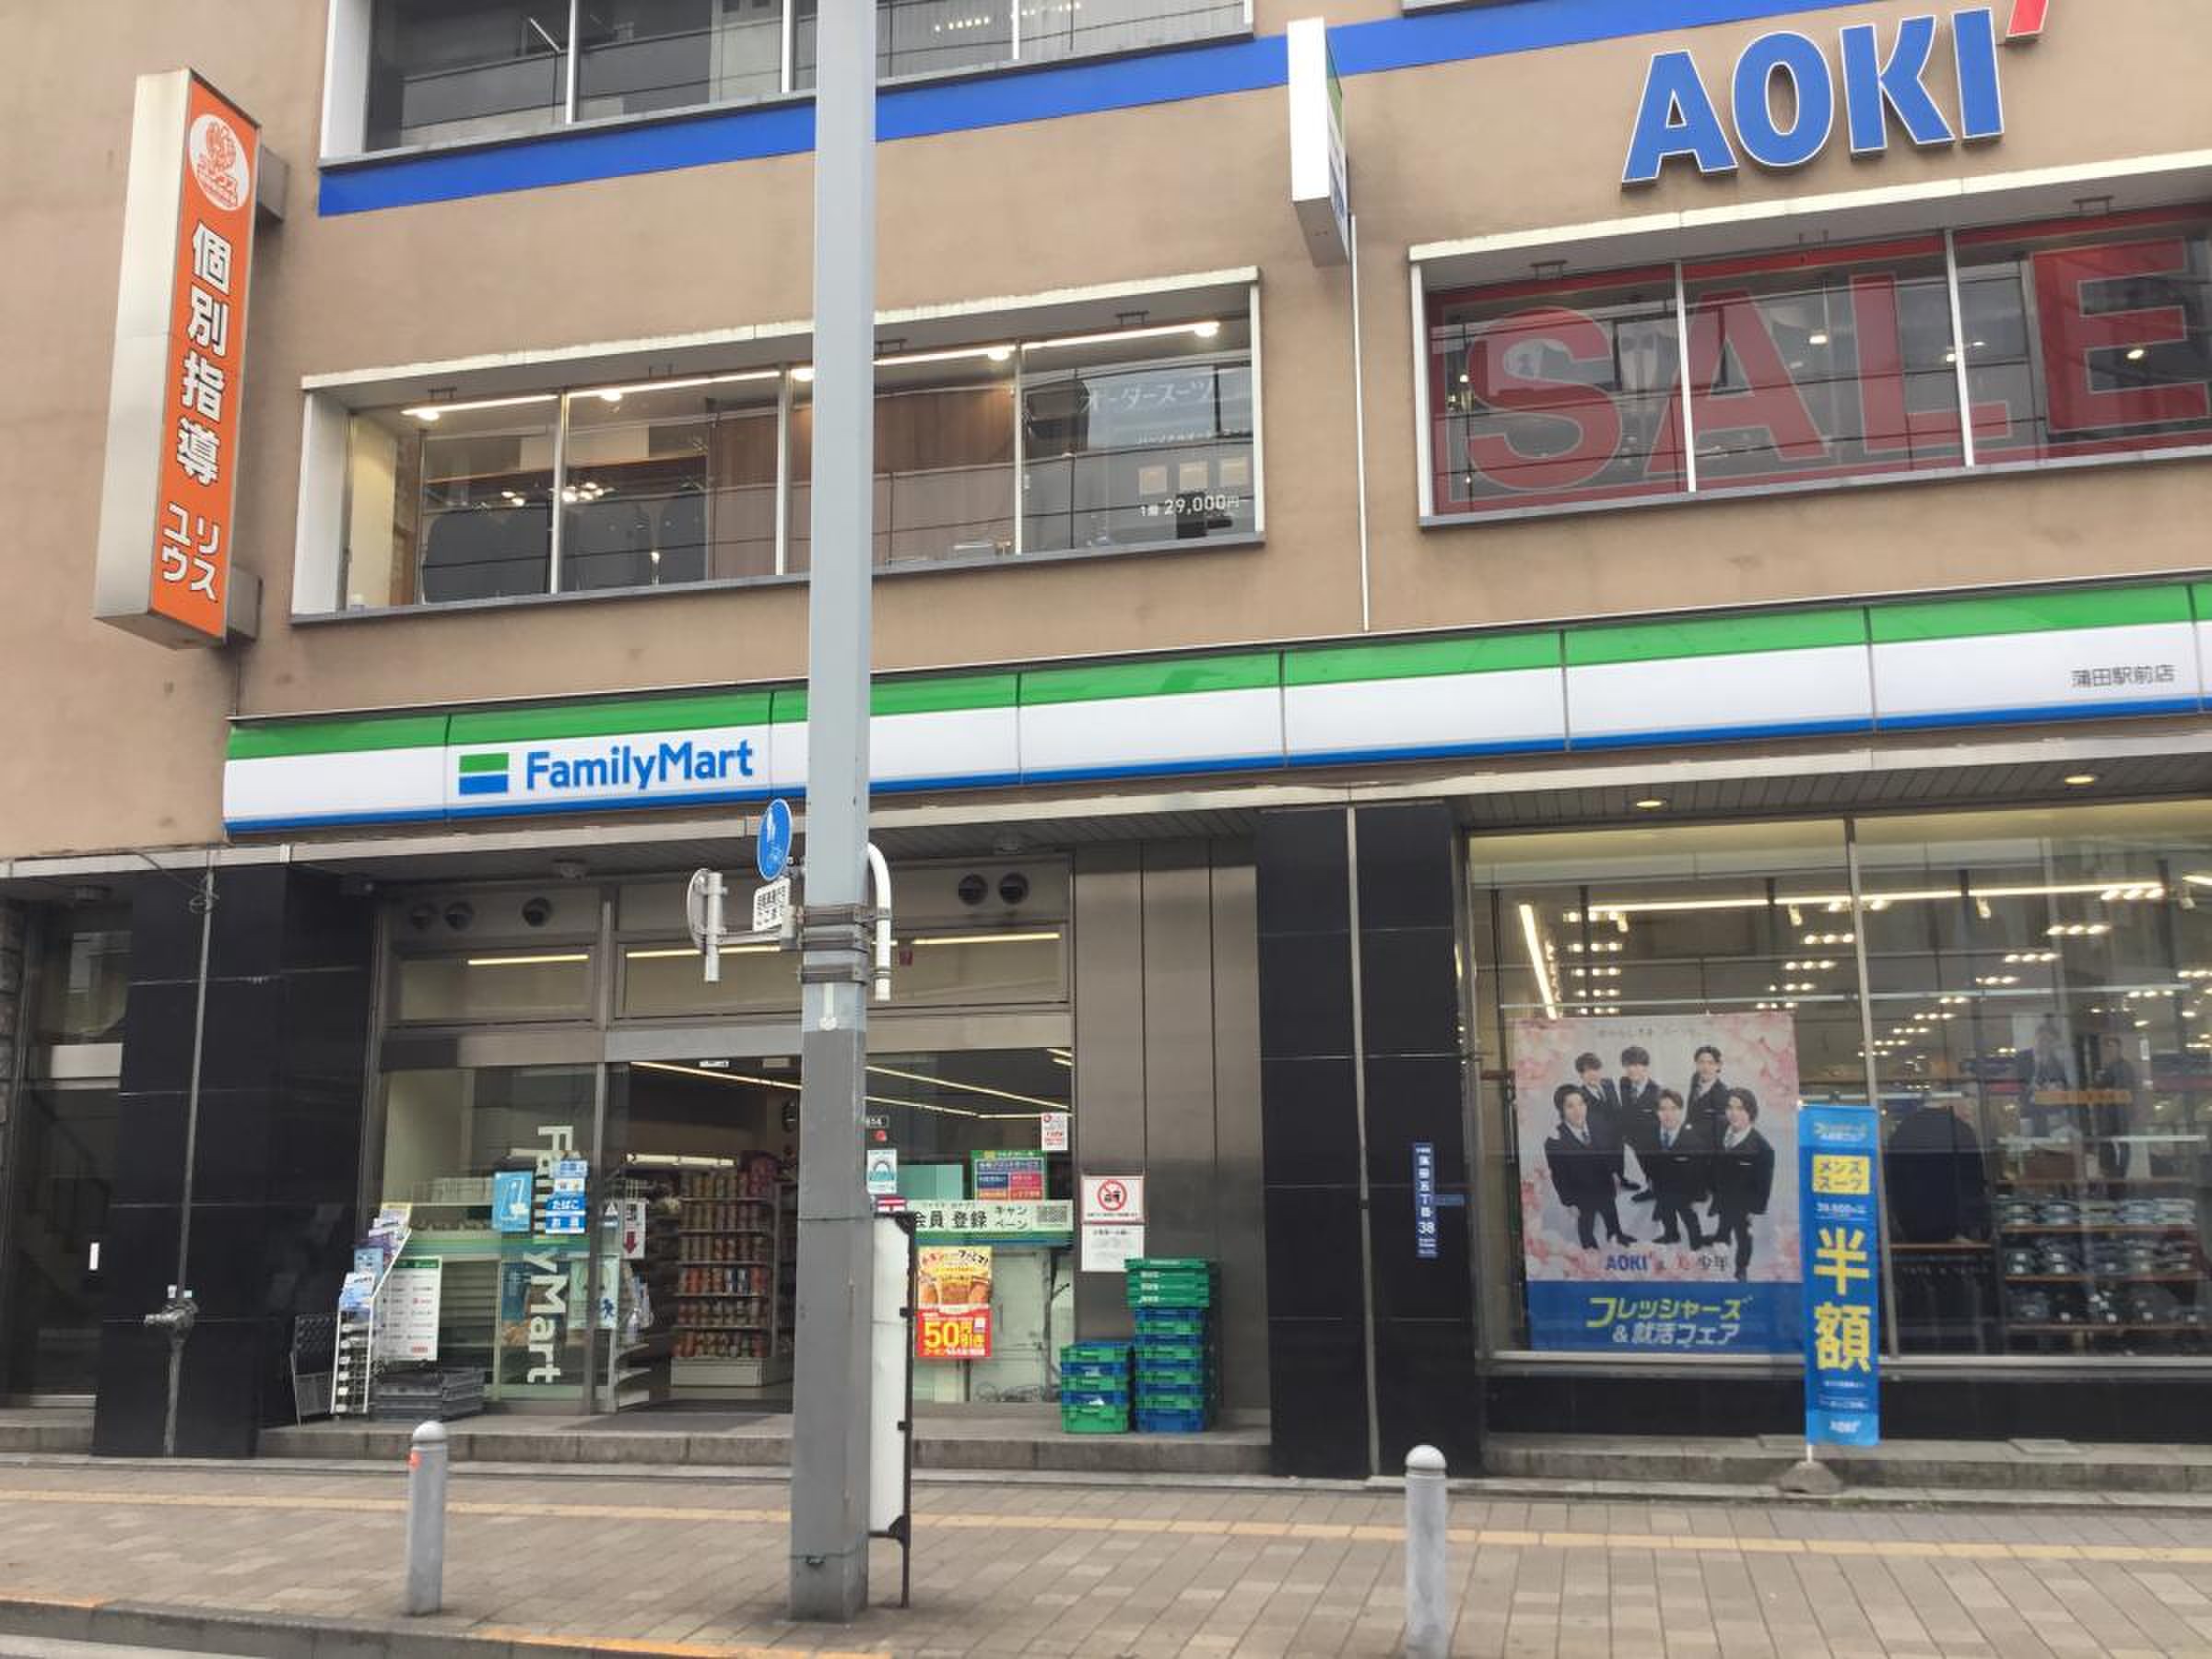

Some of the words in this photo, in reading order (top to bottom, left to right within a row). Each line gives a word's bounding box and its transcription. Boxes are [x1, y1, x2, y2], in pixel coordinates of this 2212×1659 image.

[1621, 7, 2004, 187] AOKI
[176, 220, 232, 487] 個別指導
[1466, 236, 2211, 490] SALE
[2071, 664, 2175, 688] 蒲田駅前店
[526, 739, 754, 791] FamilyMart
[952, 1210, 988, 1230] 登録
[1418, 1221, 1435, 1234] 38
[1605, 1253, 1648, 1271] AOKI
[1585, 1294, 1753, 1328] フレッシャーズ
[1814, 1227, 1871, 1372] 半額
